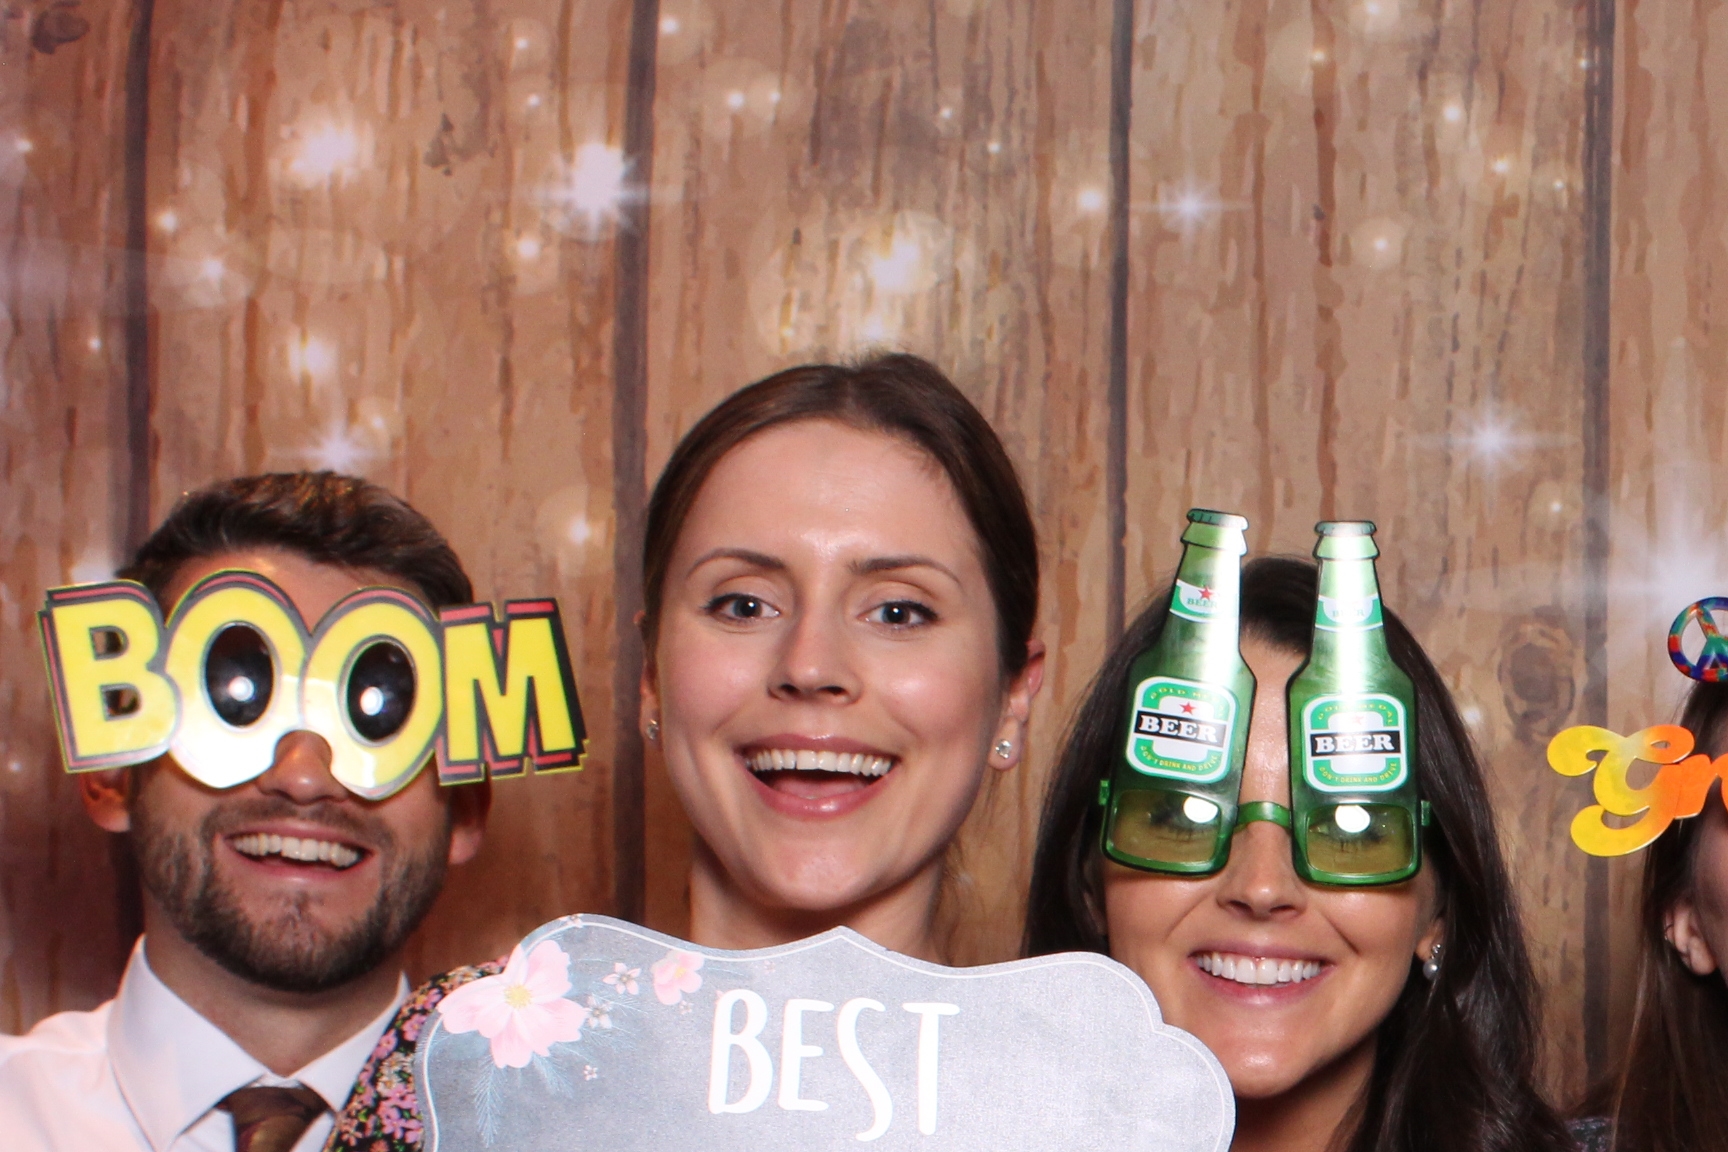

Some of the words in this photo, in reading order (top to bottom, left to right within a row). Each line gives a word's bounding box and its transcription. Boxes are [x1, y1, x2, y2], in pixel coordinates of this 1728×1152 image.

[40, 569, 588, 800] BOOM
[1139, 714, 1217, 743] BEER
[1315, 734, 1395, 754] BEER
[708, 989, 961, 1142] BEST
